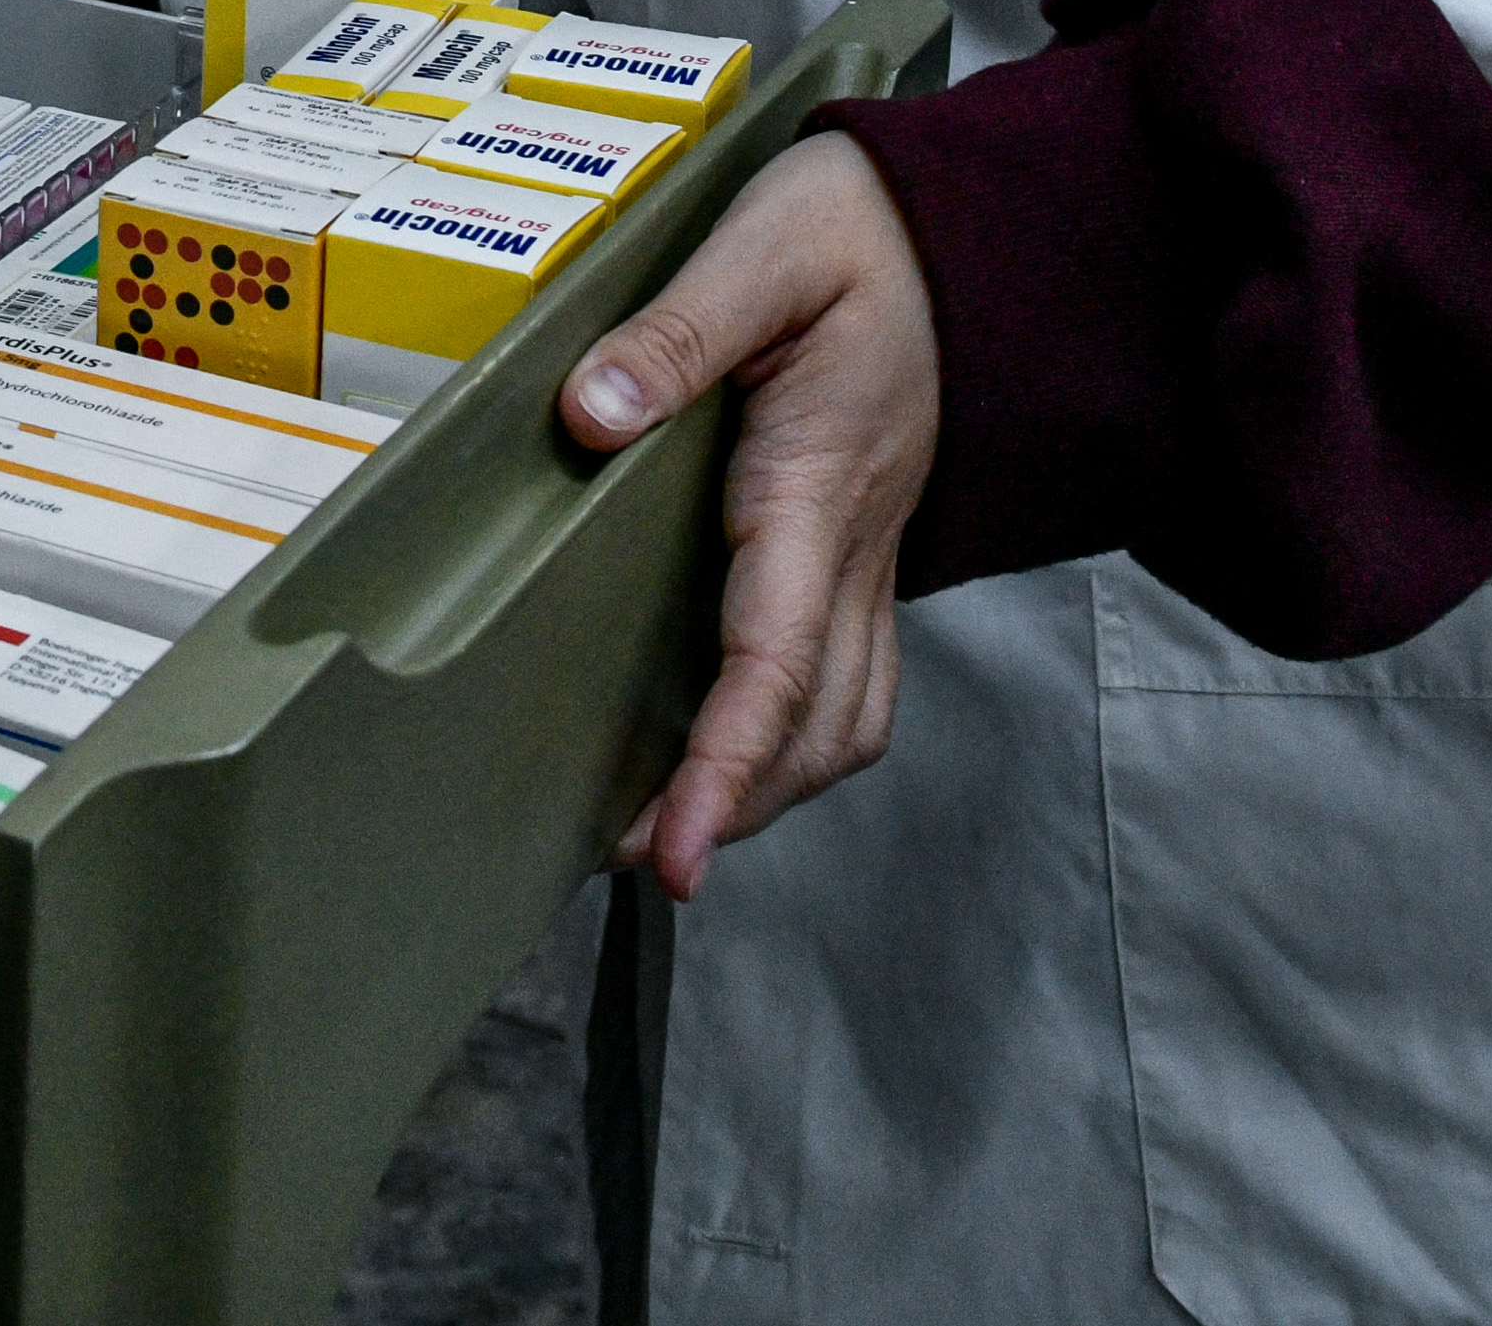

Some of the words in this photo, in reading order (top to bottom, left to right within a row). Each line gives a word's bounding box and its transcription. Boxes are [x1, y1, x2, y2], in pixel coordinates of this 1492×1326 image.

[307, 13, 381, 66] Minocin
[350, 45, 373, 68] 100
[370, 22, 409, 53] mg/cap
[412, 29, 485, 82] Minocin
[577, 37, 674, 61] mg/cap
[456, 62, 480, 86] 100
[476, 40, 514, 72] mg/cap
[545, 48, 701, 86] Minocin
[678, 52, 711, 66] 50
[494, 121, 591, 148] mg/cap
[597, 142, 631, 156] 50
[456, 130, 618, 179] Minocin
[410, 196, 510, 226] mg/cap
[518, 219, 552, 234] 50
[370, 205, 538, 257] Minocin
